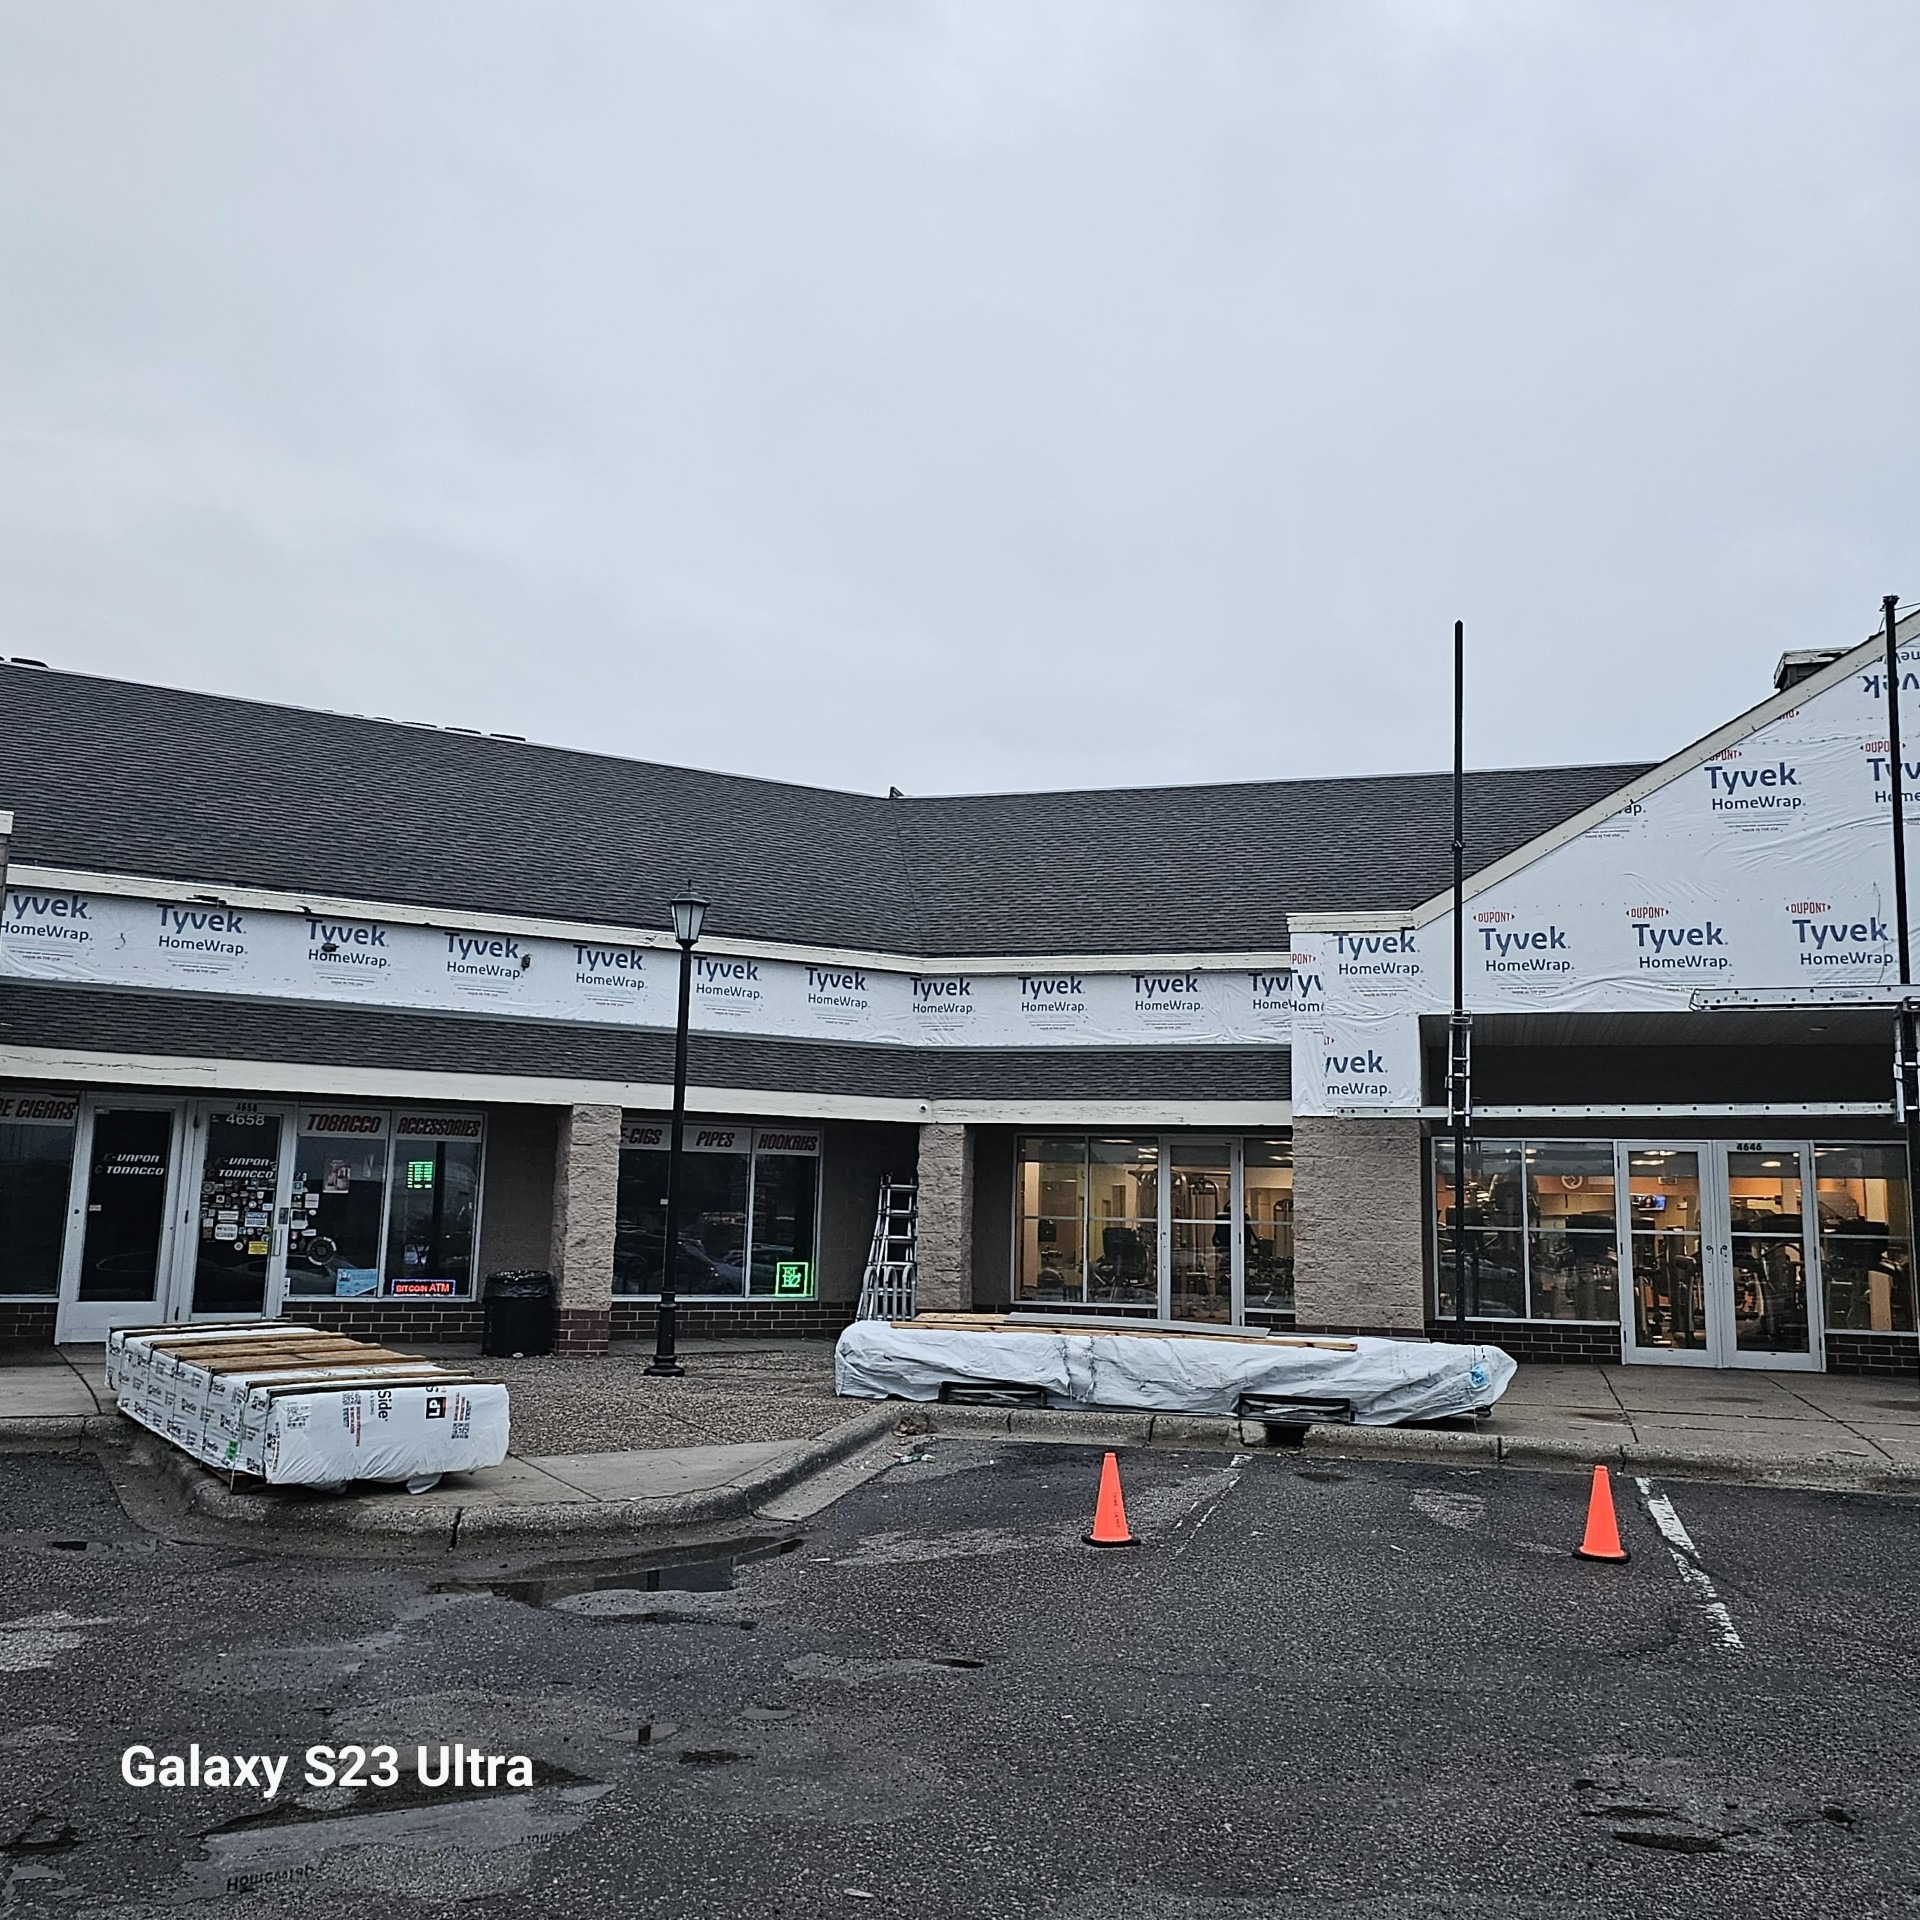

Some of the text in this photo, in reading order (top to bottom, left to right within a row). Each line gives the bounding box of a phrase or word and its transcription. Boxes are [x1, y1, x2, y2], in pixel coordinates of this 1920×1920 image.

[15, 1100, 76, 1119] CIGARS
[236, 1103, 258, 1113] 4658
[226, 1114, 265, 1126] 4658
[307, 1114, 382, 1133] TOBACCO
[396, 1117, 481, 1137] ACCESSORIES
[696, 1131, 735, 1148] PIPES
[758, 1134, 818, 1151] HOOKAHS
[1736, 1142, 1762, 1151] 4646
[429, 1283, 450, 1292] ATM
[429, 1399, 441, 1417] LP
